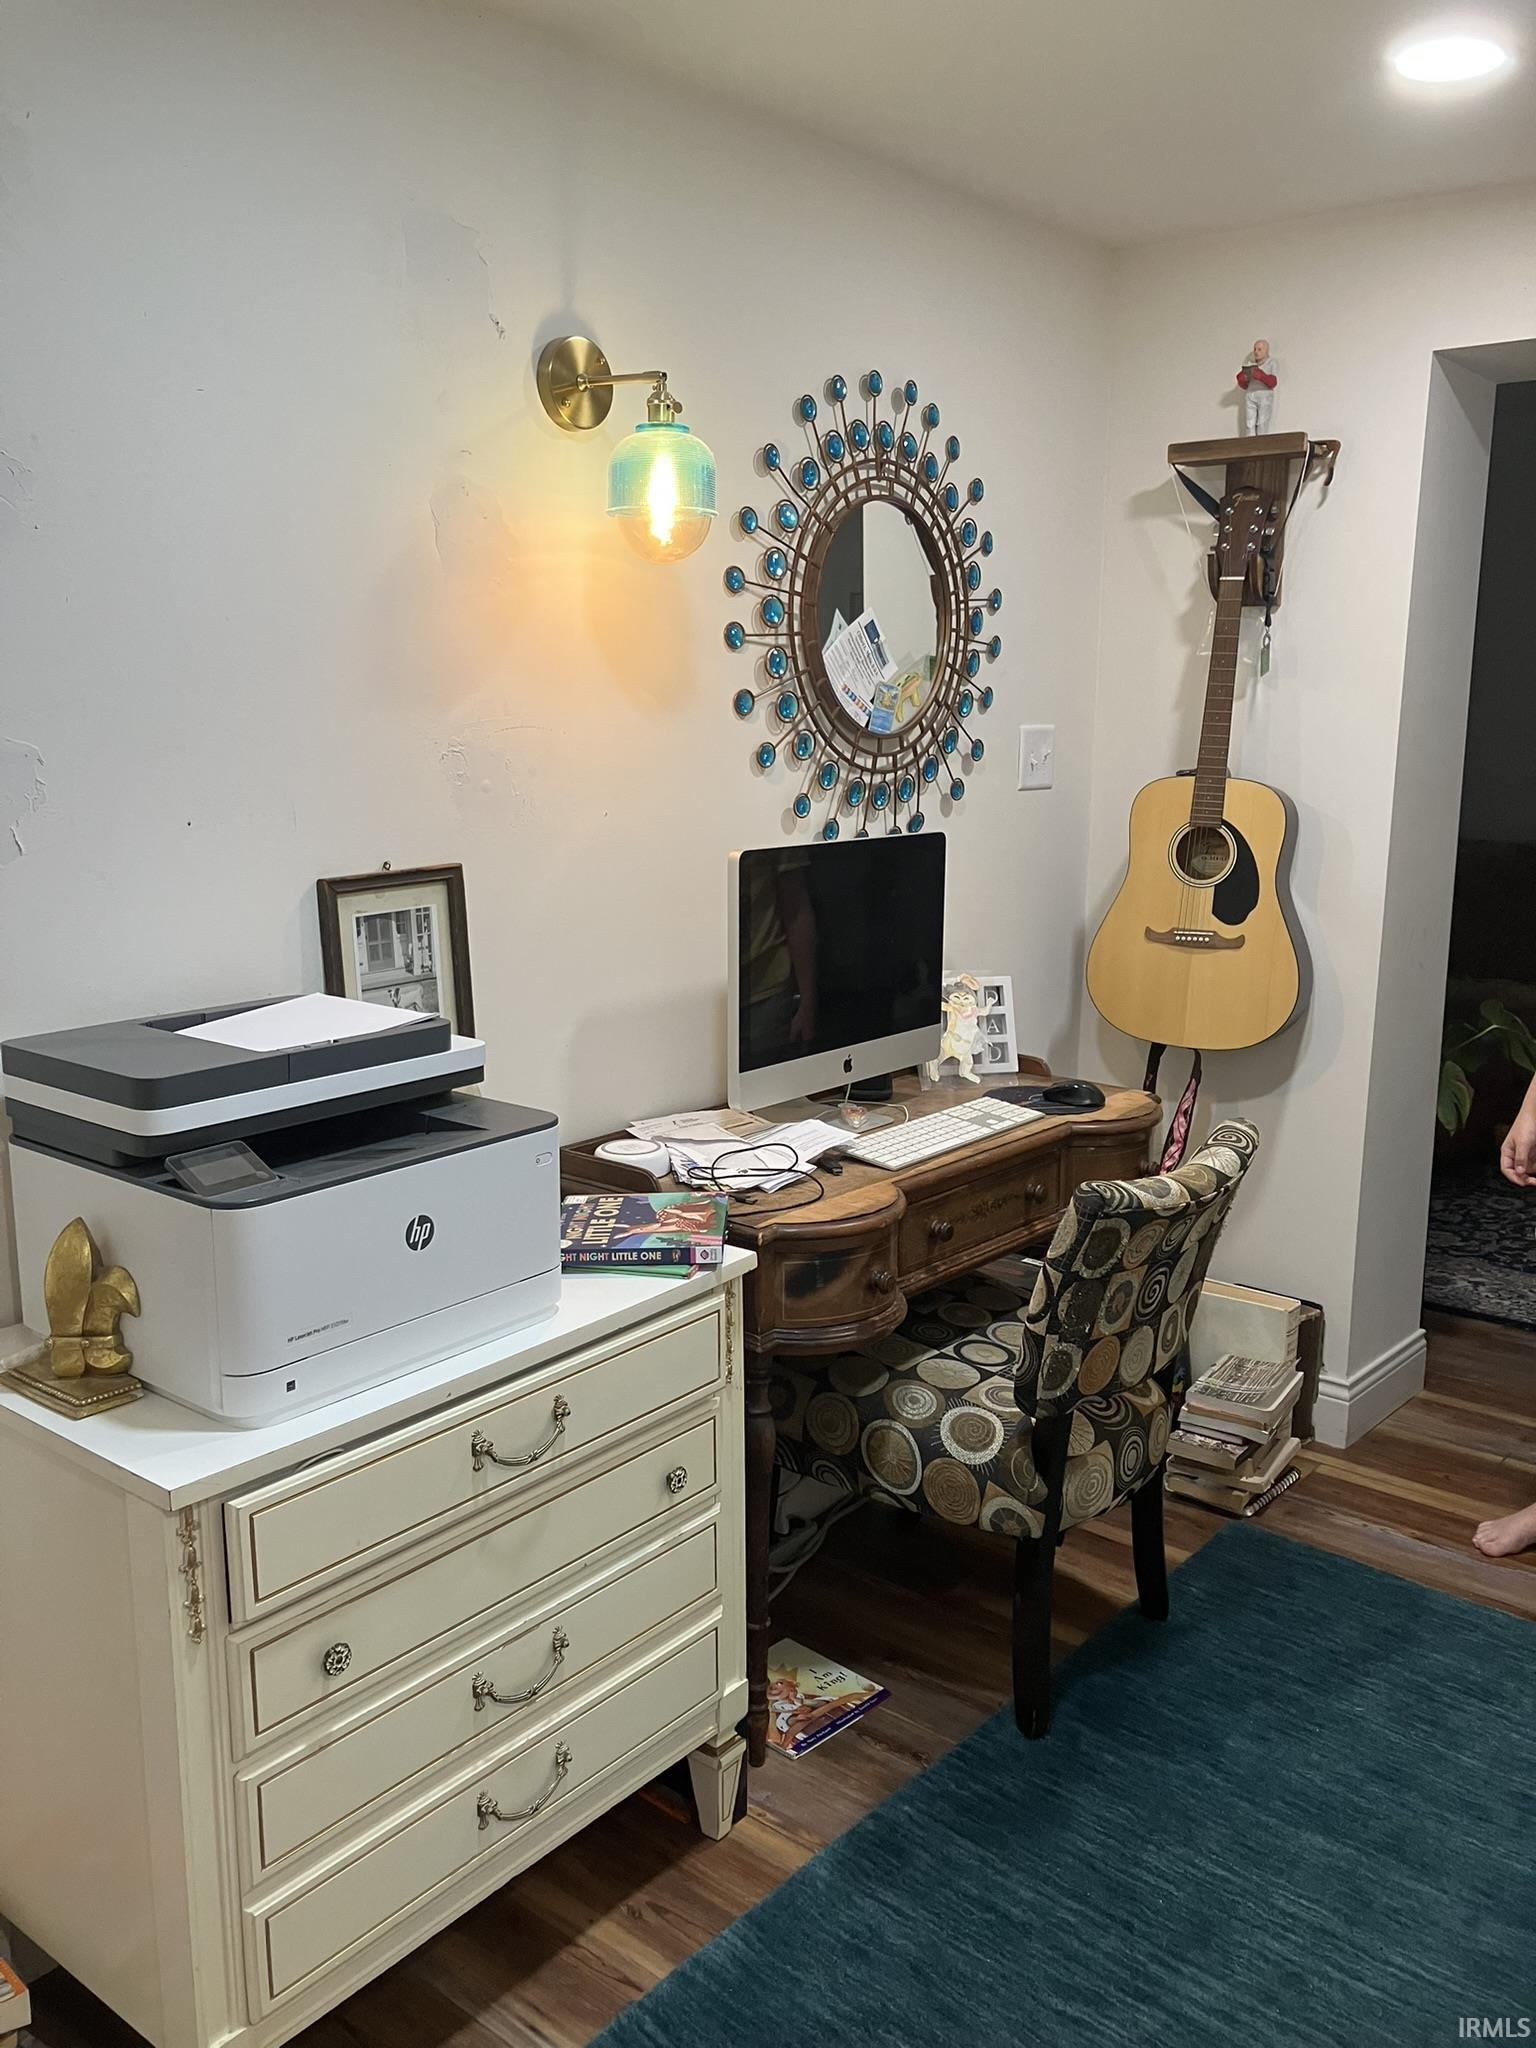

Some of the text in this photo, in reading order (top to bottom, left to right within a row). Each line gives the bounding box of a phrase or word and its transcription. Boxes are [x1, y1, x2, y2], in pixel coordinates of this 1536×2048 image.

[407, 1214, 433, 1252] hp
[581, 1197, 625, 1245] LITTLE ONE
[560, 1251, 662, 1262] GHT NIGHT LITTLE ONE
[813, 1671, 833, 1683] Am
